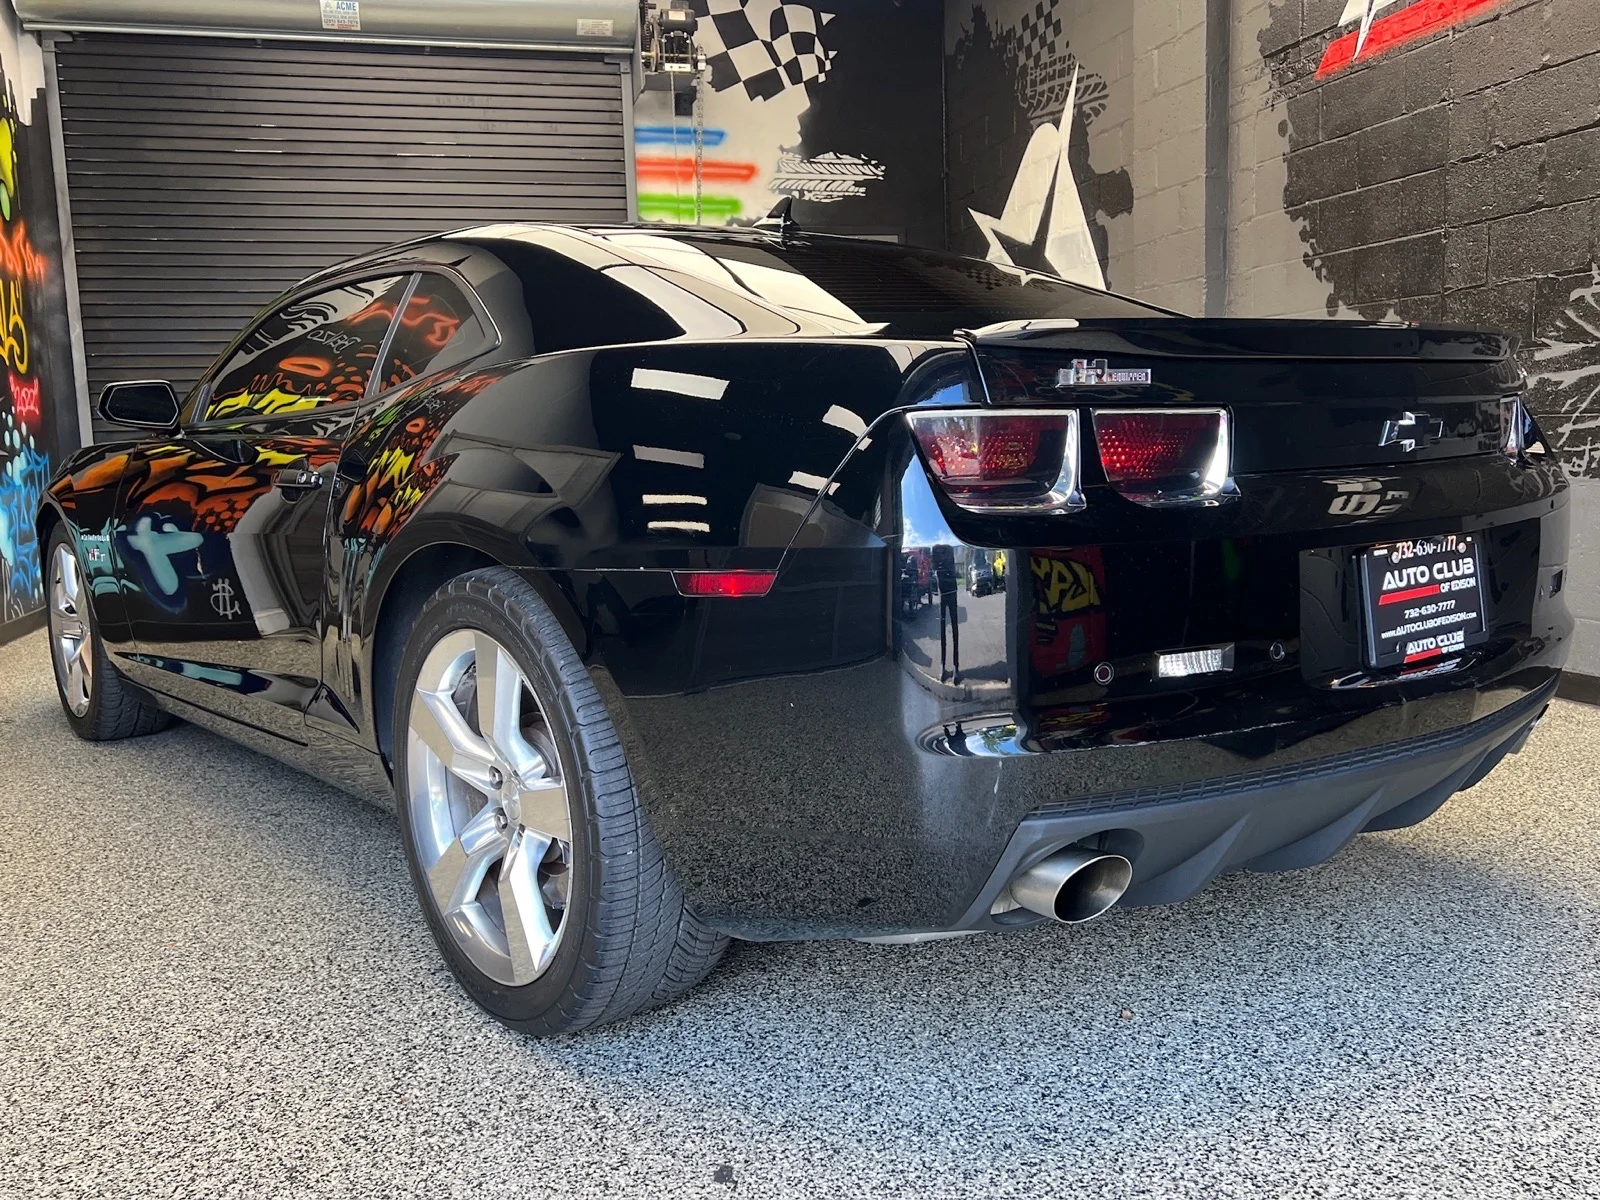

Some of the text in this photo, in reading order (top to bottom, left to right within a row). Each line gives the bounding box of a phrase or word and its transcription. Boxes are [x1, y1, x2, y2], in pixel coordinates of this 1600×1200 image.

[336, 1, 357, 11] ACME
[1382, 557, 1475, 591] AUTO CLUB
[1440, 577, 1476, 593] OF EDISON
[1404, 600, 1456, 619] 732-630-7777
[1406, 630, 1465, 655] AUTO CLUB
